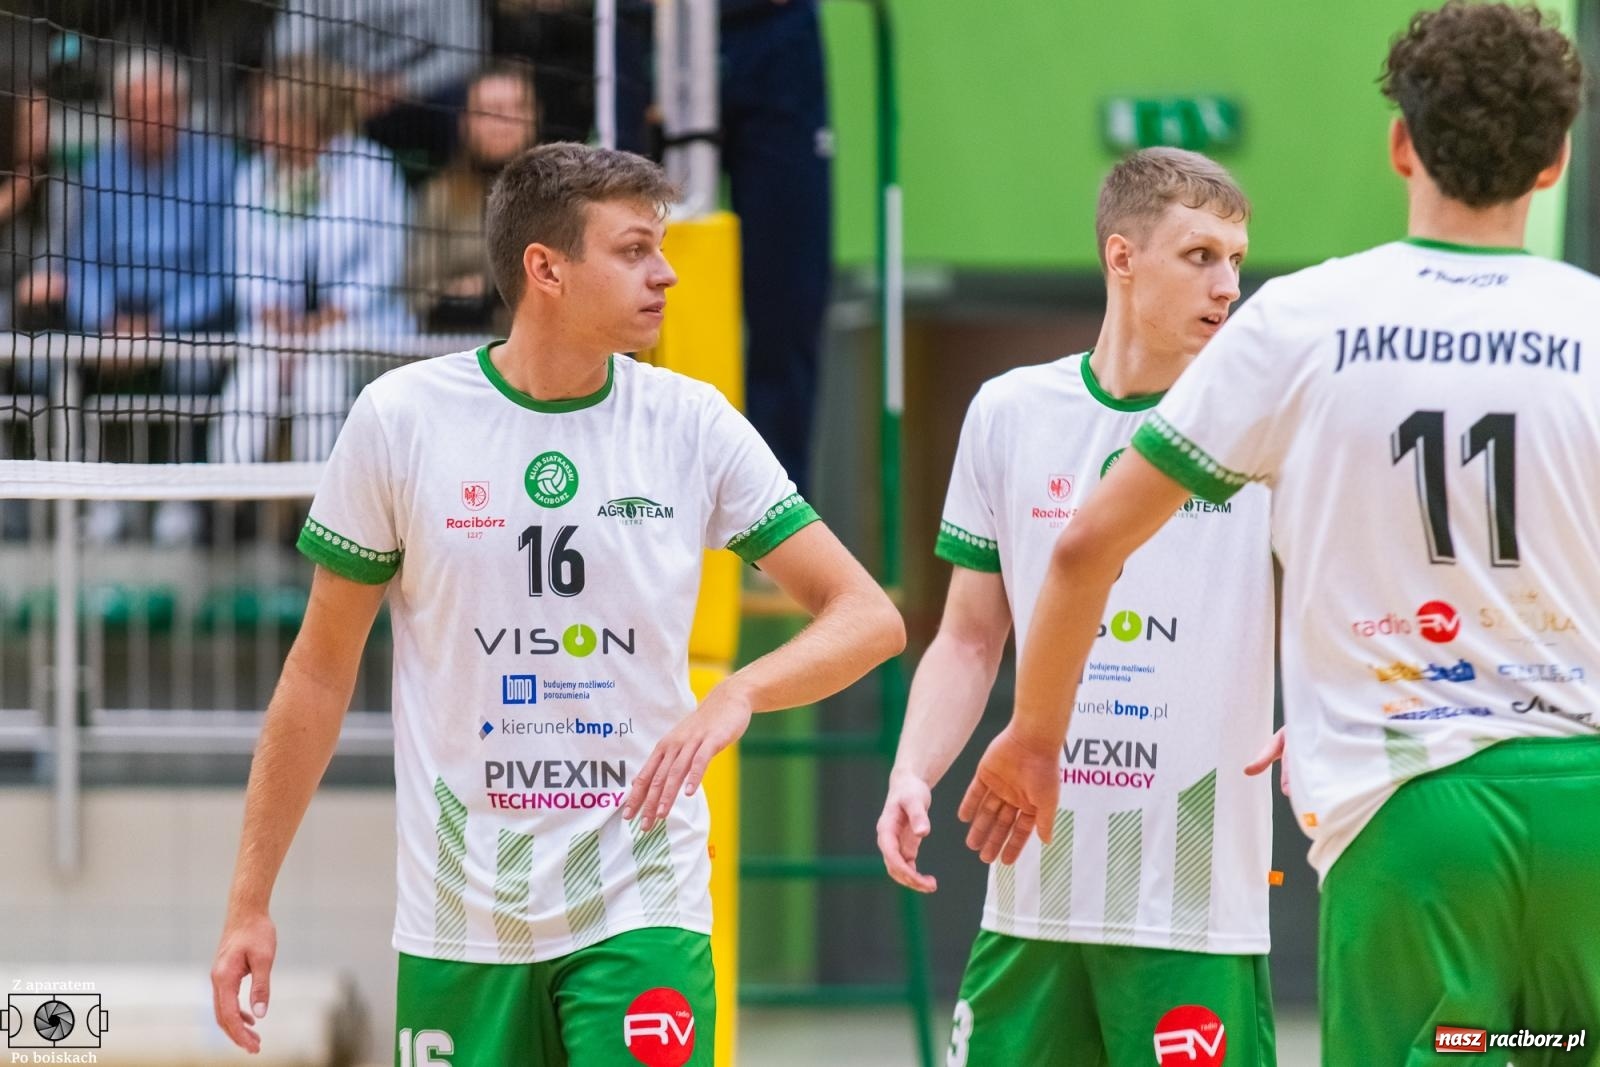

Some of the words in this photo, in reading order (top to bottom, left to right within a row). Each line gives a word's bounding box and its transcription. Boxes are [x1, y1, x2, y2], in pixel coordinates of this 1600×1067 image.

[1334, 325, 1581, 374] JAKUBOWSKI
[529, 461, 542, 480] KLUB
[542, 455, 575, 481] SIATKARSKI
[1391, 410, 1520, 568] 11
[446, 516, 505, 528] Racibórz
[518, 525, 585, 597] 16
[1352, 613, 1412, 637] radio
[474, 623, 635, 658] VISON
[1089, 662, 1120, 673] budujemy
[505, 676, 534, 703] bmp
[543, 680, 576, 690] budujemy
[578, 680, 615, 689] możliwości
[543, 690, 590, 700] porozumienia
[502, 718, 633, 738] kierunekbmp.pl
[1063, 738, 1158, 769] VEXIN
[485, 760, 626, 789] PIVEXIN
[1060, 768, 1155, 789] HNOLOGY
[487, 791, 624, 809] TECHNOLOGY
[624, 1012, 694, 1047] RV
[1153, 1023, 1225, 1064] RV
